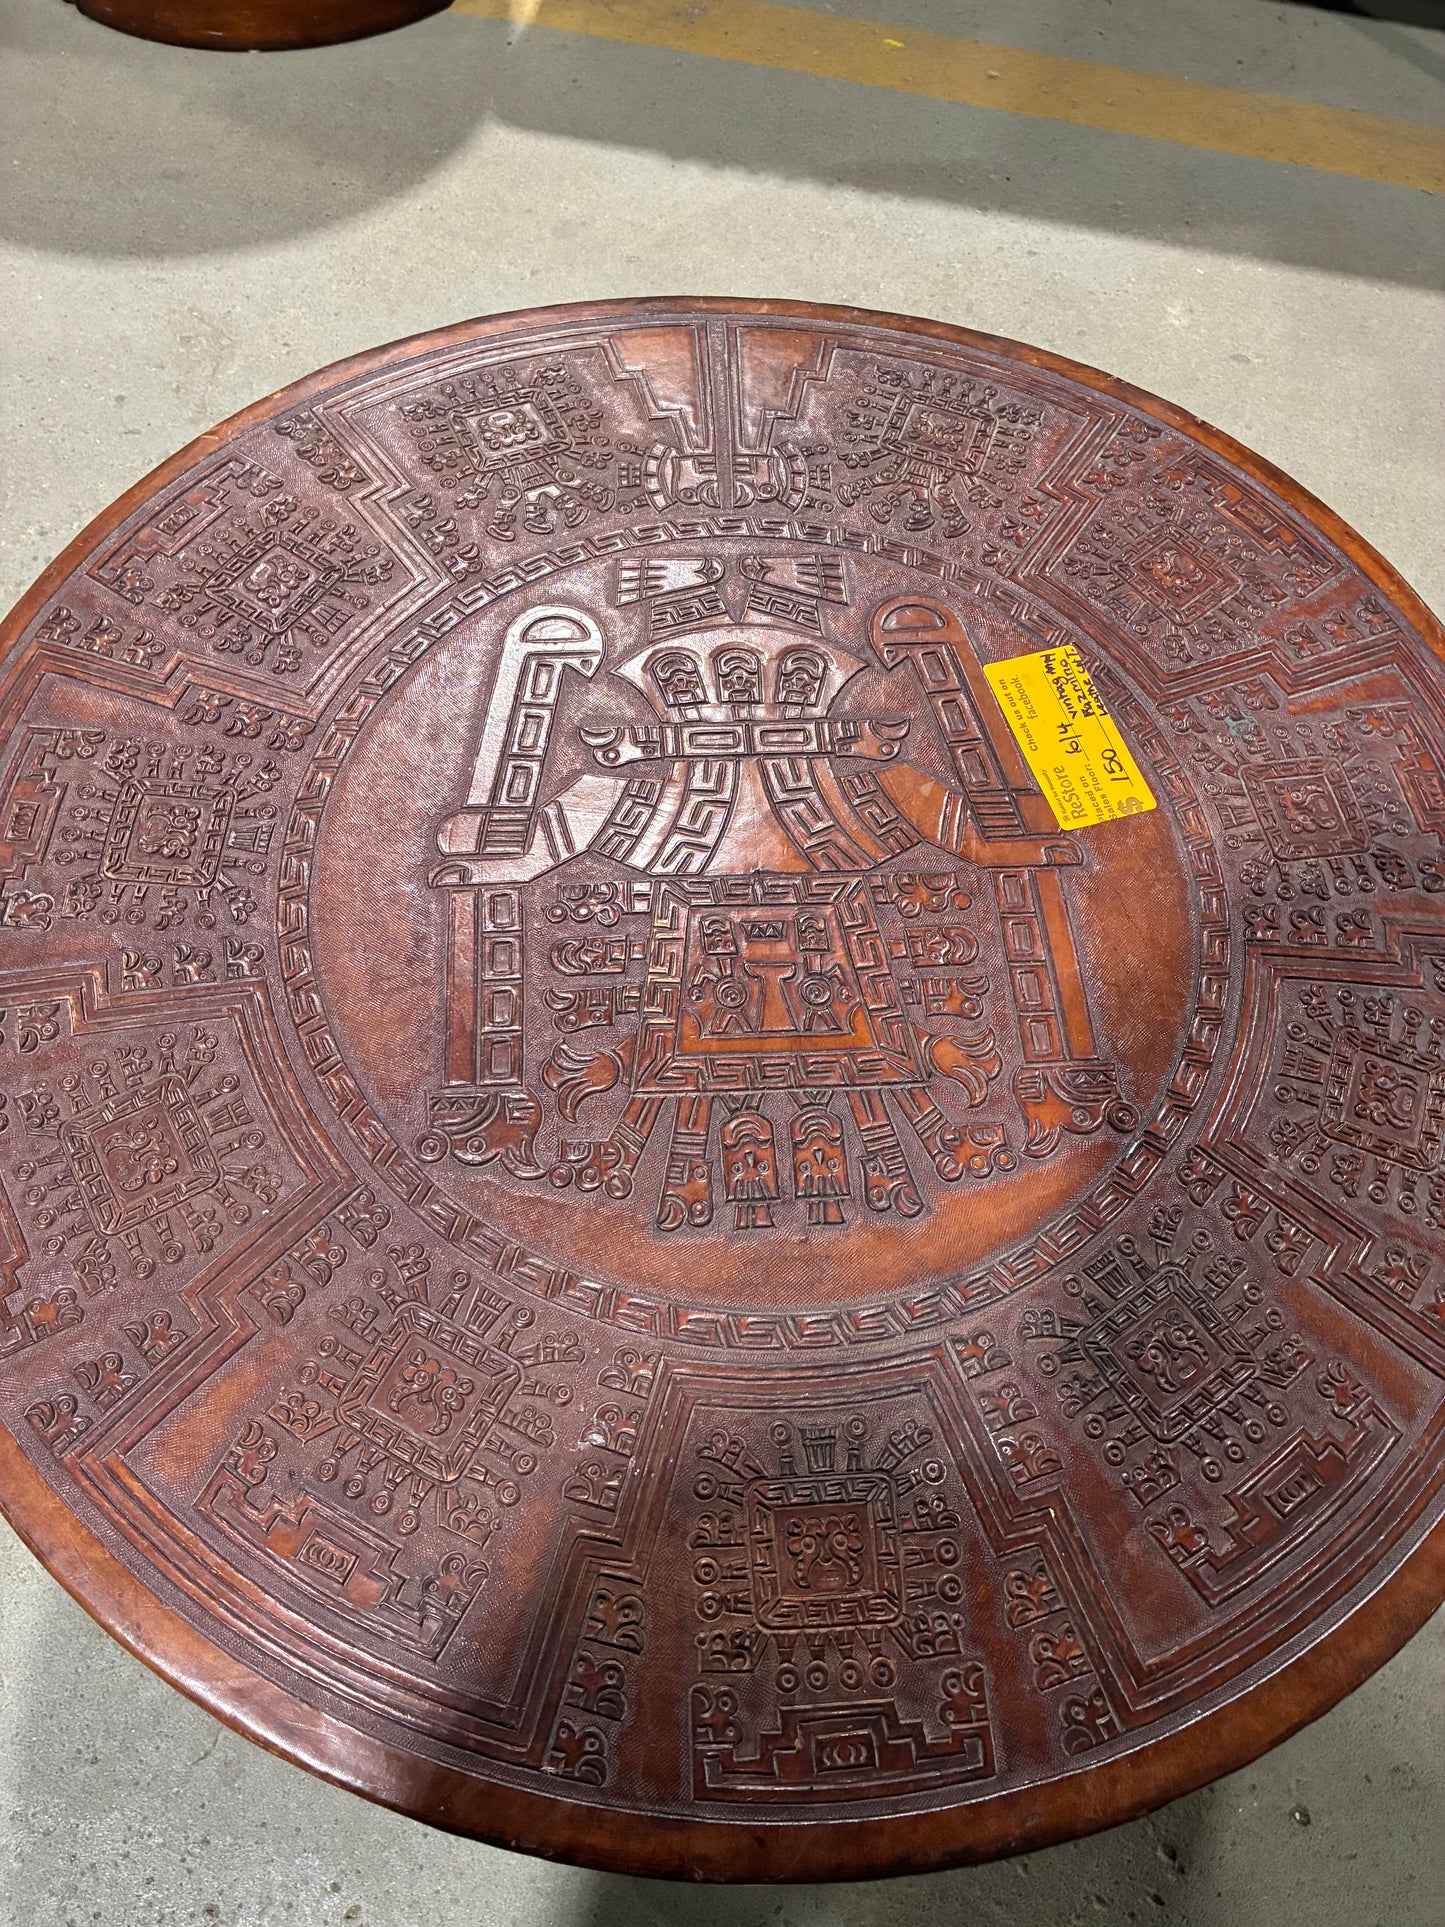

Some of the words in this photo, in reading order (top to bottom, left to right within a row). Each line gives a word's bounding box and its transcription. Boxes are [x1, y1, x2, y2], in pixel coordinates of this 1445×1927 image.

[998, 678, 1009, 691] on
[1003, 691, 1016, 708] out
[1012, 708, 1023, 721] us
[1020, 721, 1038, 751] Check
[1084, 763, 1103, 792] Floor:
[1101, 748, 1130, 782] 150
[1053, 765, 1088, 820] ReStore
[1078, 775, 1090, 788] on
[1084, 789, 1107, 823] Placed
[1099, 792, 1117, 820] Sales
[1117, 796, 1145, 816] $
